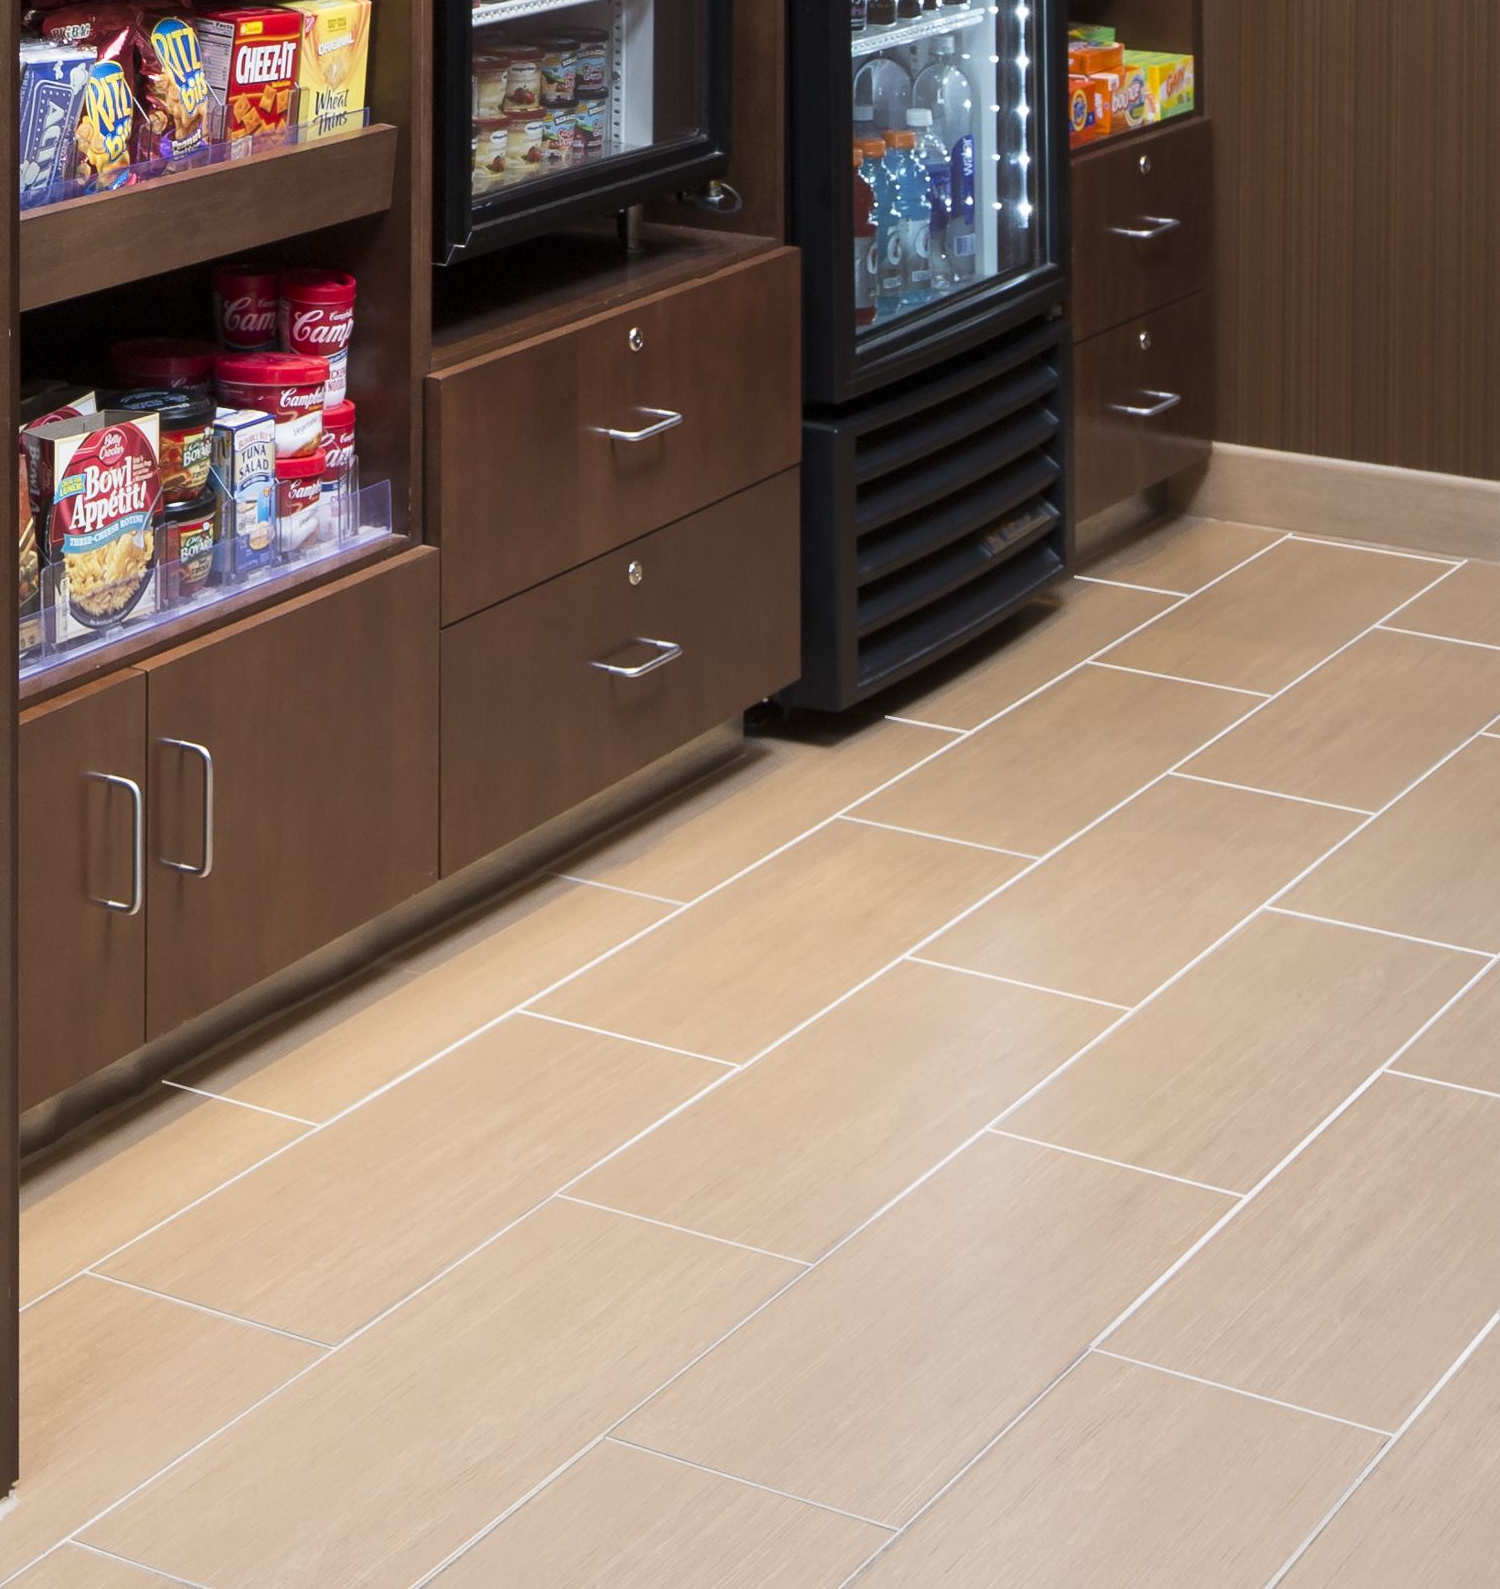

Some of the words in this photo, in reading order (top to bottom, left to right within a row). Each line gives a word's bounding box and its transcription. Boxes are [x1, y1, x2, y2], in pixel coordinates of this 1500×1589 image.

[151, 27, 203, 83] RITZ
[235, 41, 296, 85] CHEEZ-IT
[86, 70, 133, 133] RITZ
[315, 88, 349, 116] Wheat
[238, 458, 269, 481] SALAD
[241, 444, 267, 463] TUNA
[84, 455, 133, 501] Bowl
[69, 480, 147, 533] Appétit!
